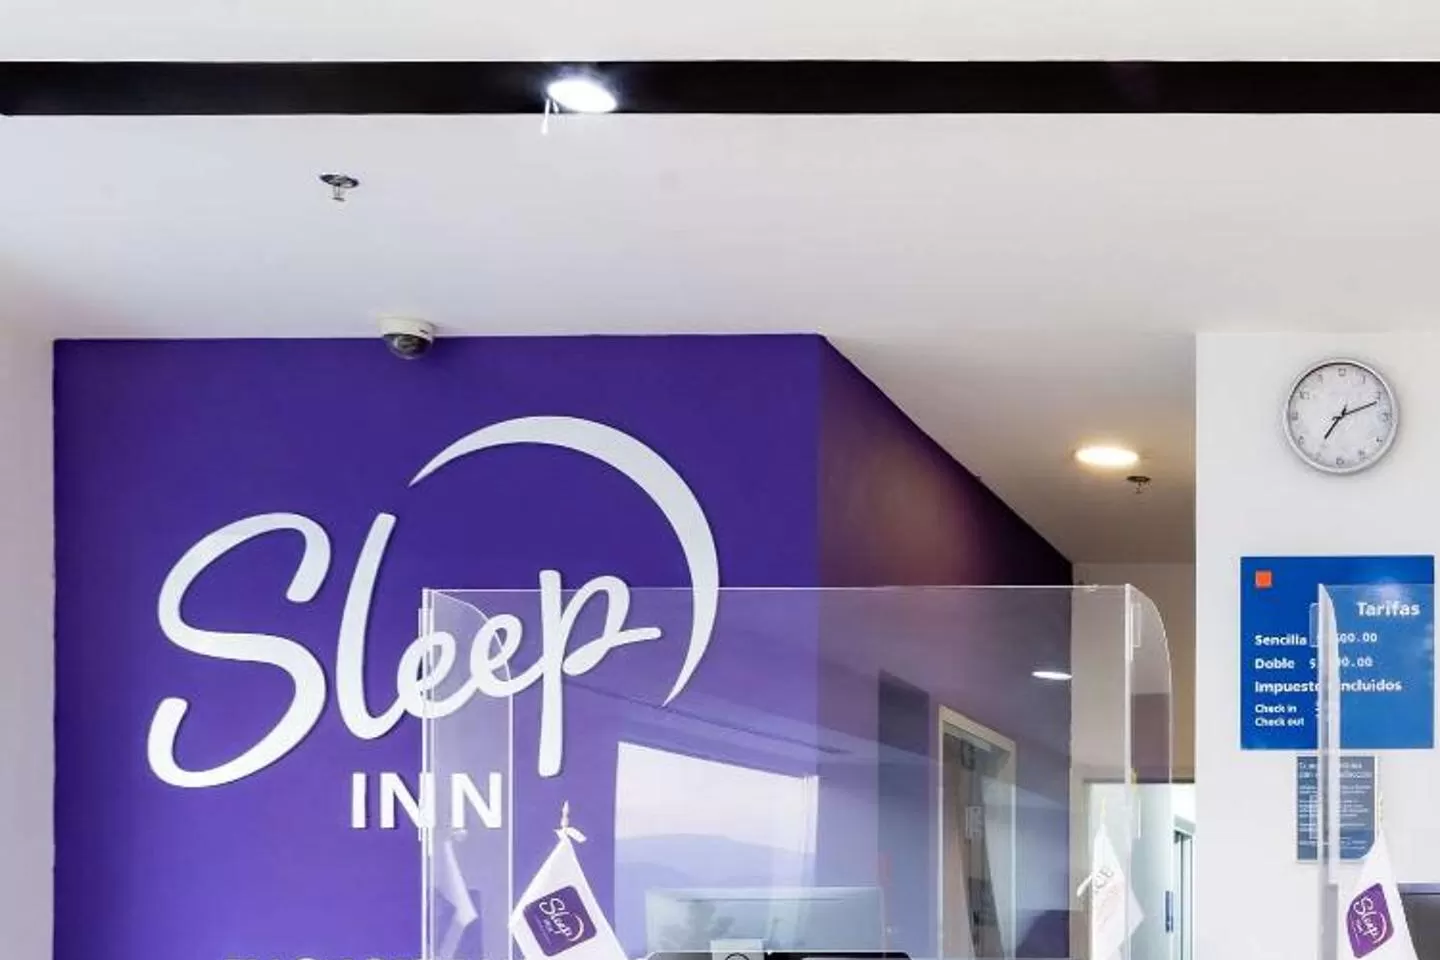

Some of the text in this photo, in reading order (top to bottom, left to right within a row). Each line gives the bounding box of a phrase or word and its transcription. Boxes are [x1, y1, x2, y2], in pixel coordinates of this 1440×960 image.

[1356, 602, 1421, 617] Tarifas
[1254, 633, 1308, 647] Sencilla
[147, 512, 661, 788] Sleep
[1254, 657, 1296, 670] Doble
[1254, 703, 1286, 714] Check
[1254, 716, 1305, 728] Check out
[351, 772, 502, 829] INN
